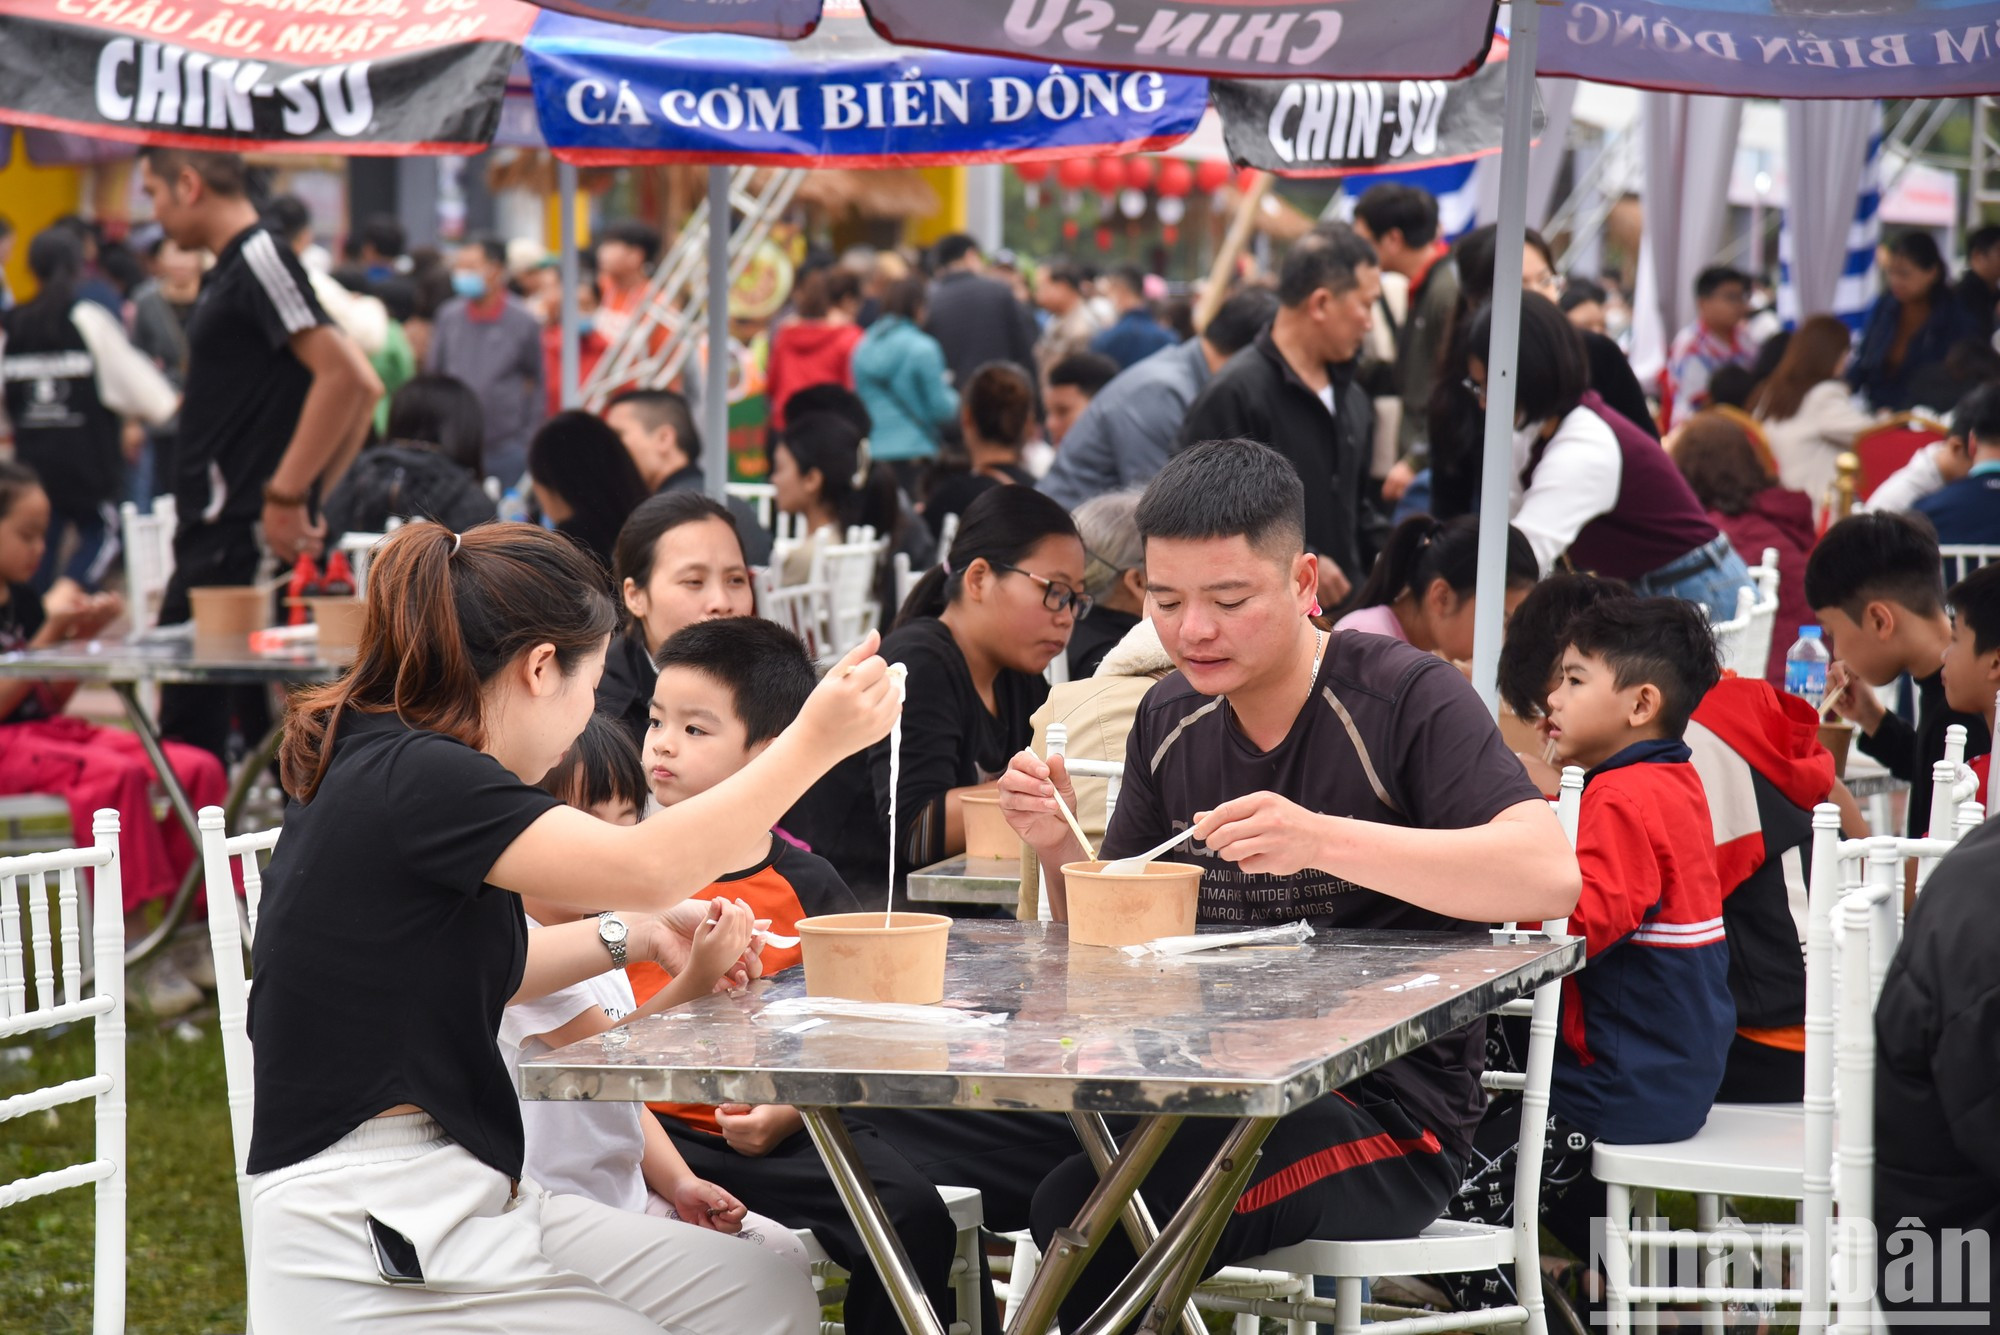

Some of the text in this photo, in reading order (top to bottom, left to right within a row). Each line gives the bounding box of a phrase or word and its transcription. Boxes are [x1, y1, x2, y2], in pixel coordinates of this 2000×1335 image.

[95, 37, 374, 137] CHIN-SU
[659, 83, 803, 132] CƠM
[820, 66, 972, 130] BIỂN
[988, 63, 1167, 122] ĐÔNG
[1268, 80, 1448, 163] CHIN-SU
[1201, 868, 1231, 882] RAND
[1293, 887, 1301, 899] 3
[1304, 880, 1361, 898] STREIFE
[1202, 905, 1245, 921] MARQUE
[1251, 909, 1270, 920] AUX
[1275, 907, 1283, 919] 3
[1286, 901, 1334, 918] BANDES
